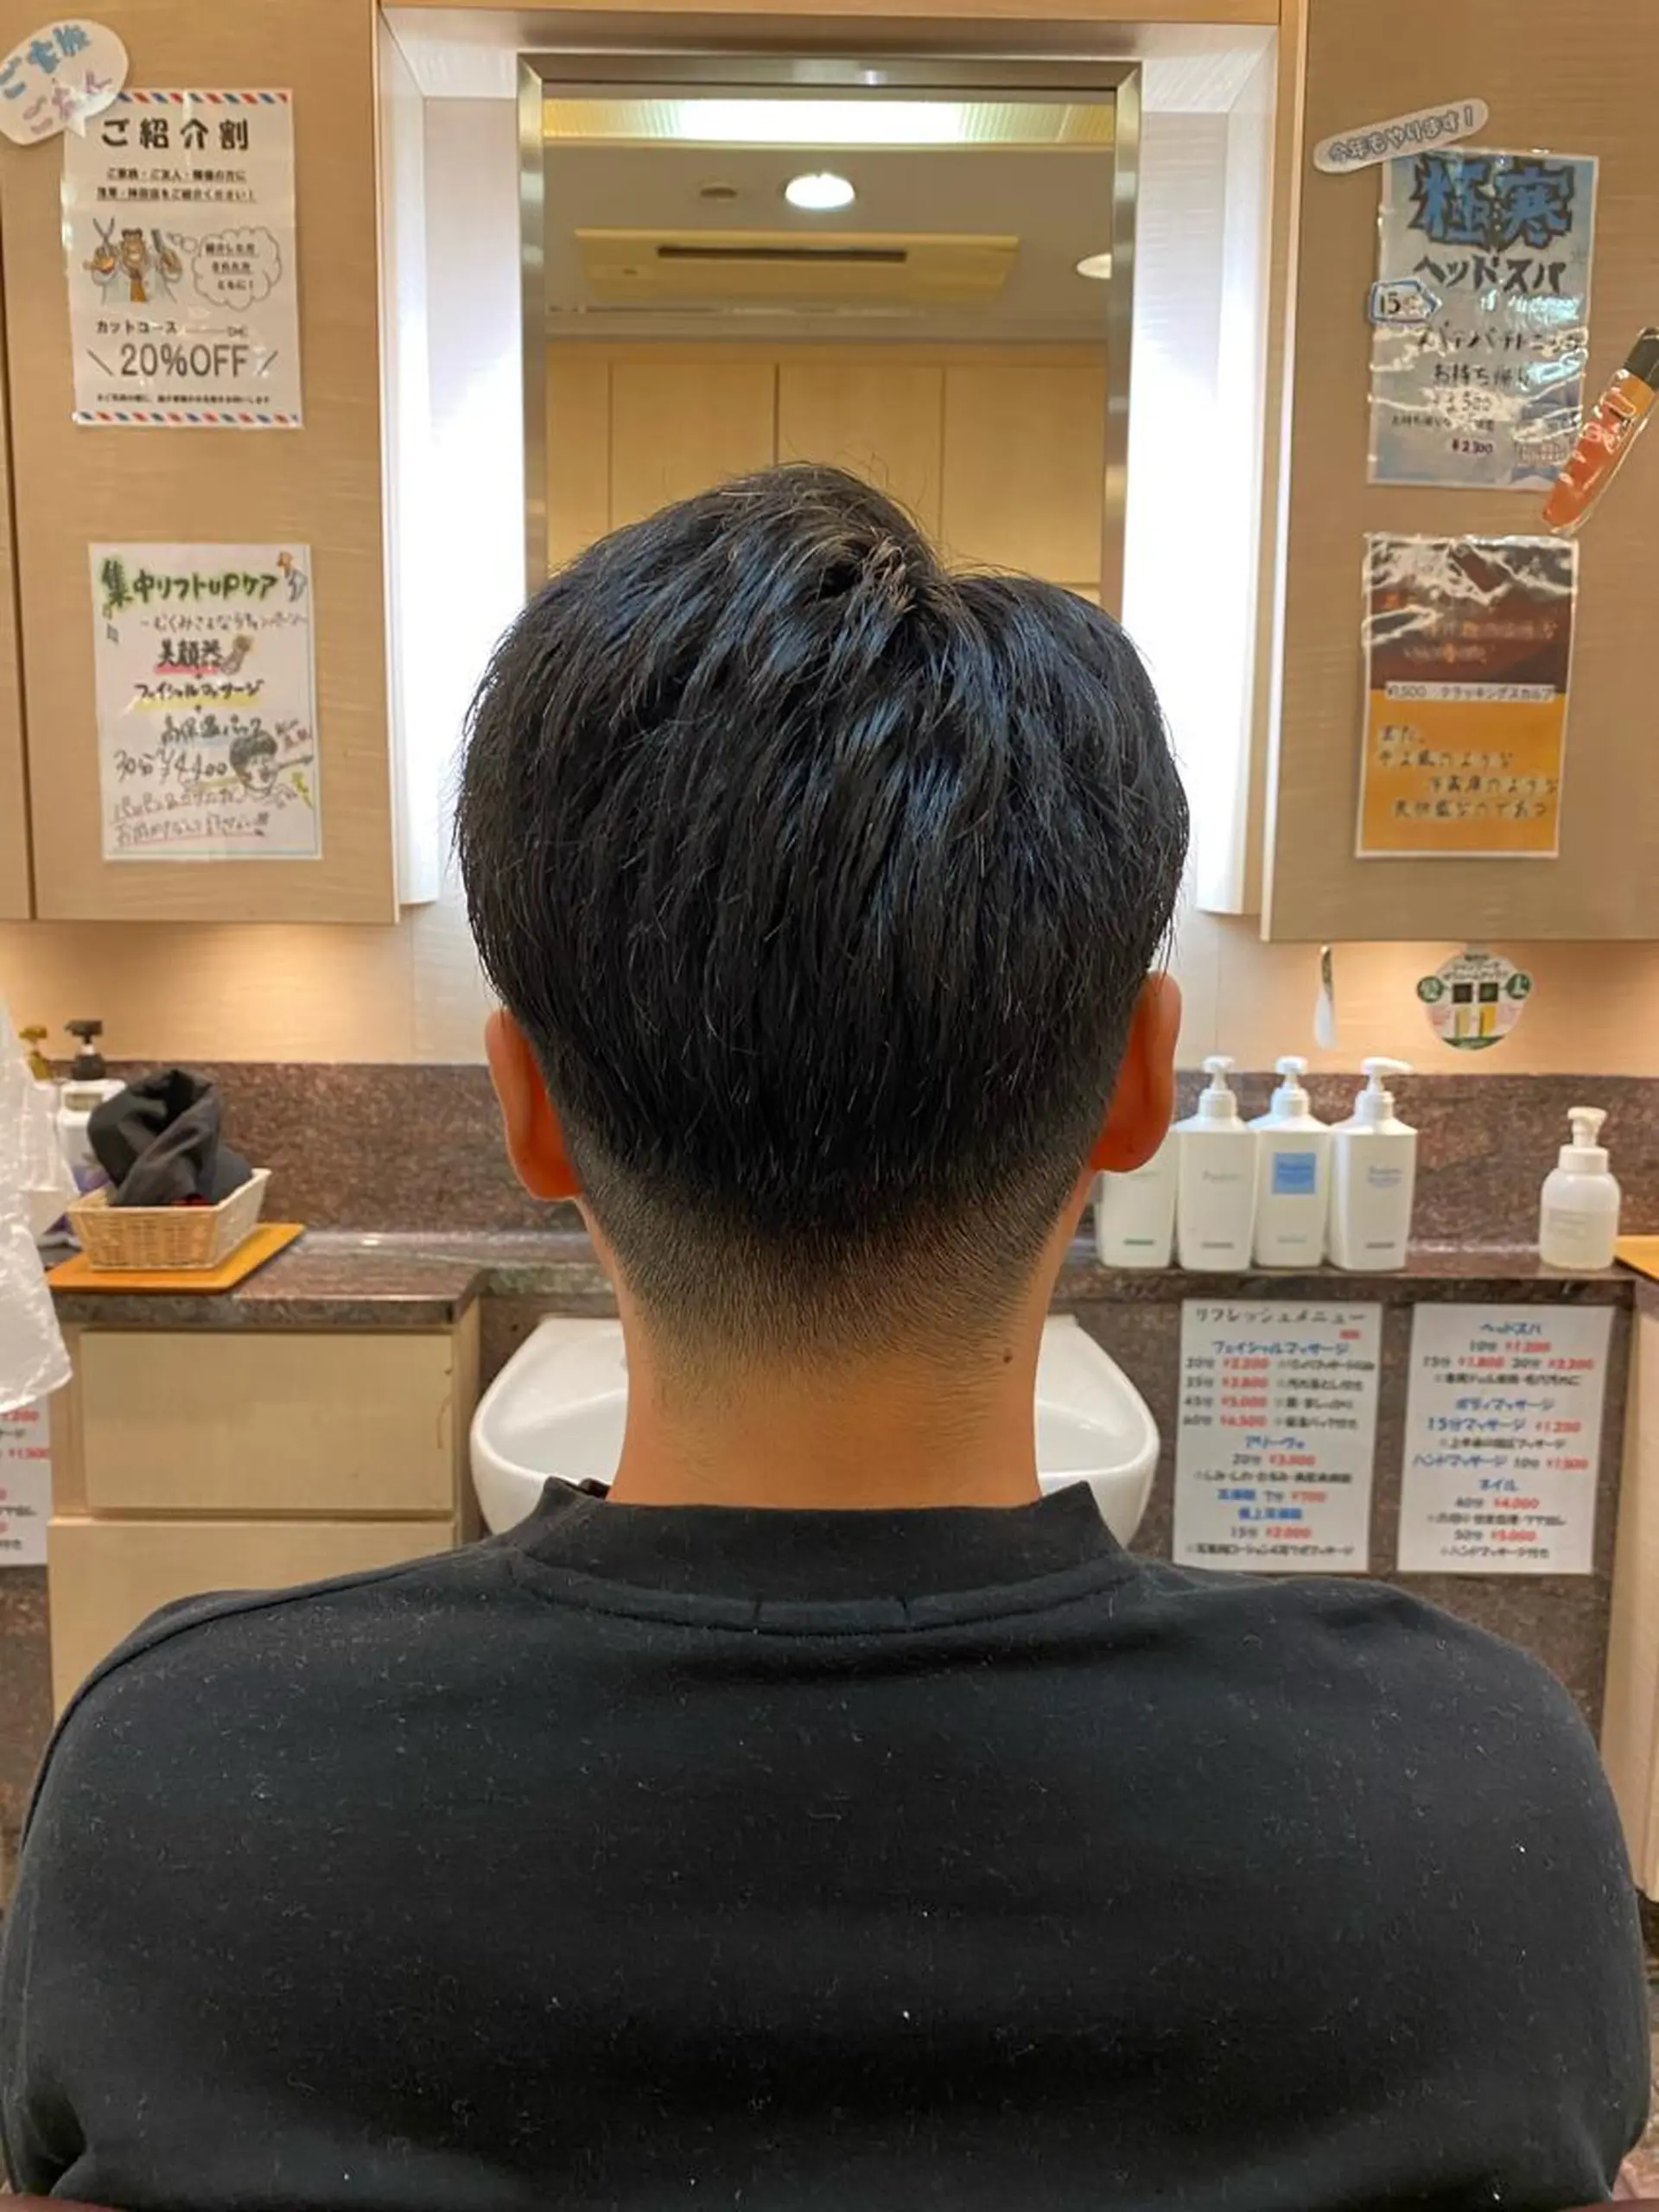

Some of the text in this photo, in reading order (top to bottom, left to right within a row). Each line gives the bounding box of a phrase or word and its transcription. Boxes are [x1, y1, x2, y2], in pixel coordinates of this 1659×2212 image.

[101, 118, 249, 150] ご紹介割
[1408, 154, 1575, 251] 極寒
[1414, 255, 1567, 294] ヘッドスパ
[97, 321, 178, 334] カットコース
[120, 342, 249, 377] 20%OFF
